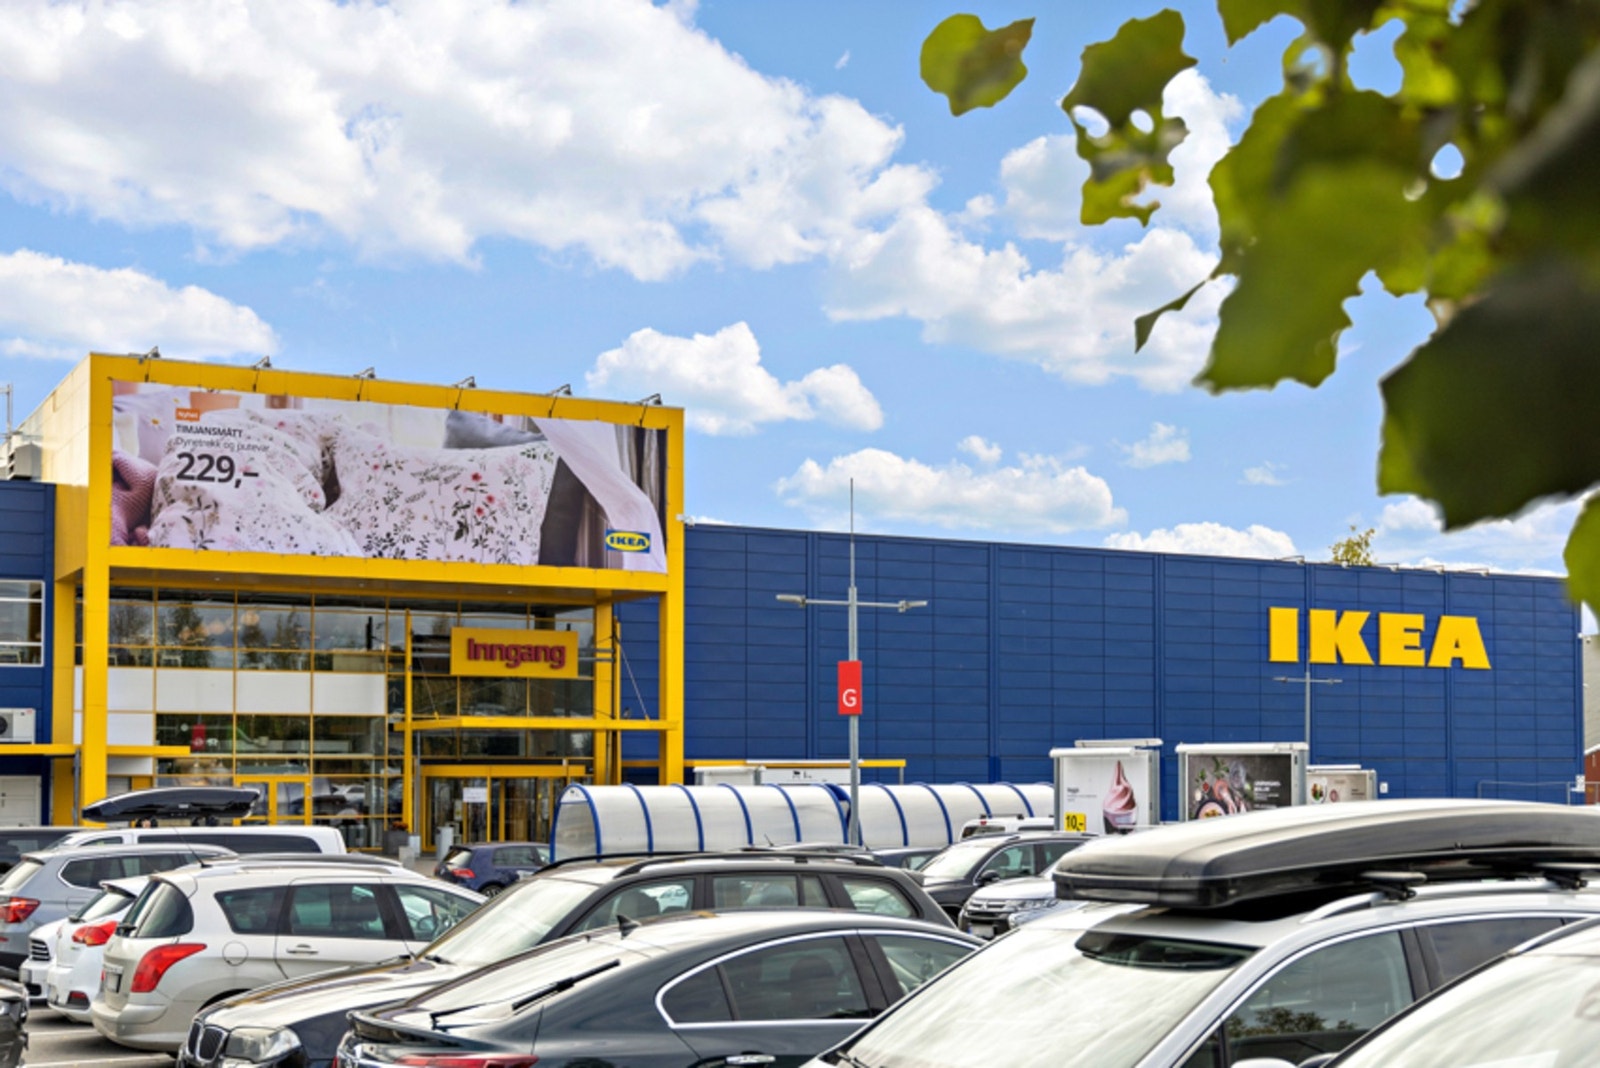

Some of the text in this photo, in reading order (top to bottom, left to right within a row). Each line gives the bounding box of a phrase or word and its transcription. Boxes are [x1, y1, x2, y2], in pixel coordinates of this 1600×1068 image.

[176, 438, 220, 448] Dynetrekk
[224, 443, 236, 453] og
[610, 536, 646, 547] IKEA
[1268, 606, 1492, 670] IKEA
[467, 638, 566, 670] Inngang
[842, 688, 857, 707] G
